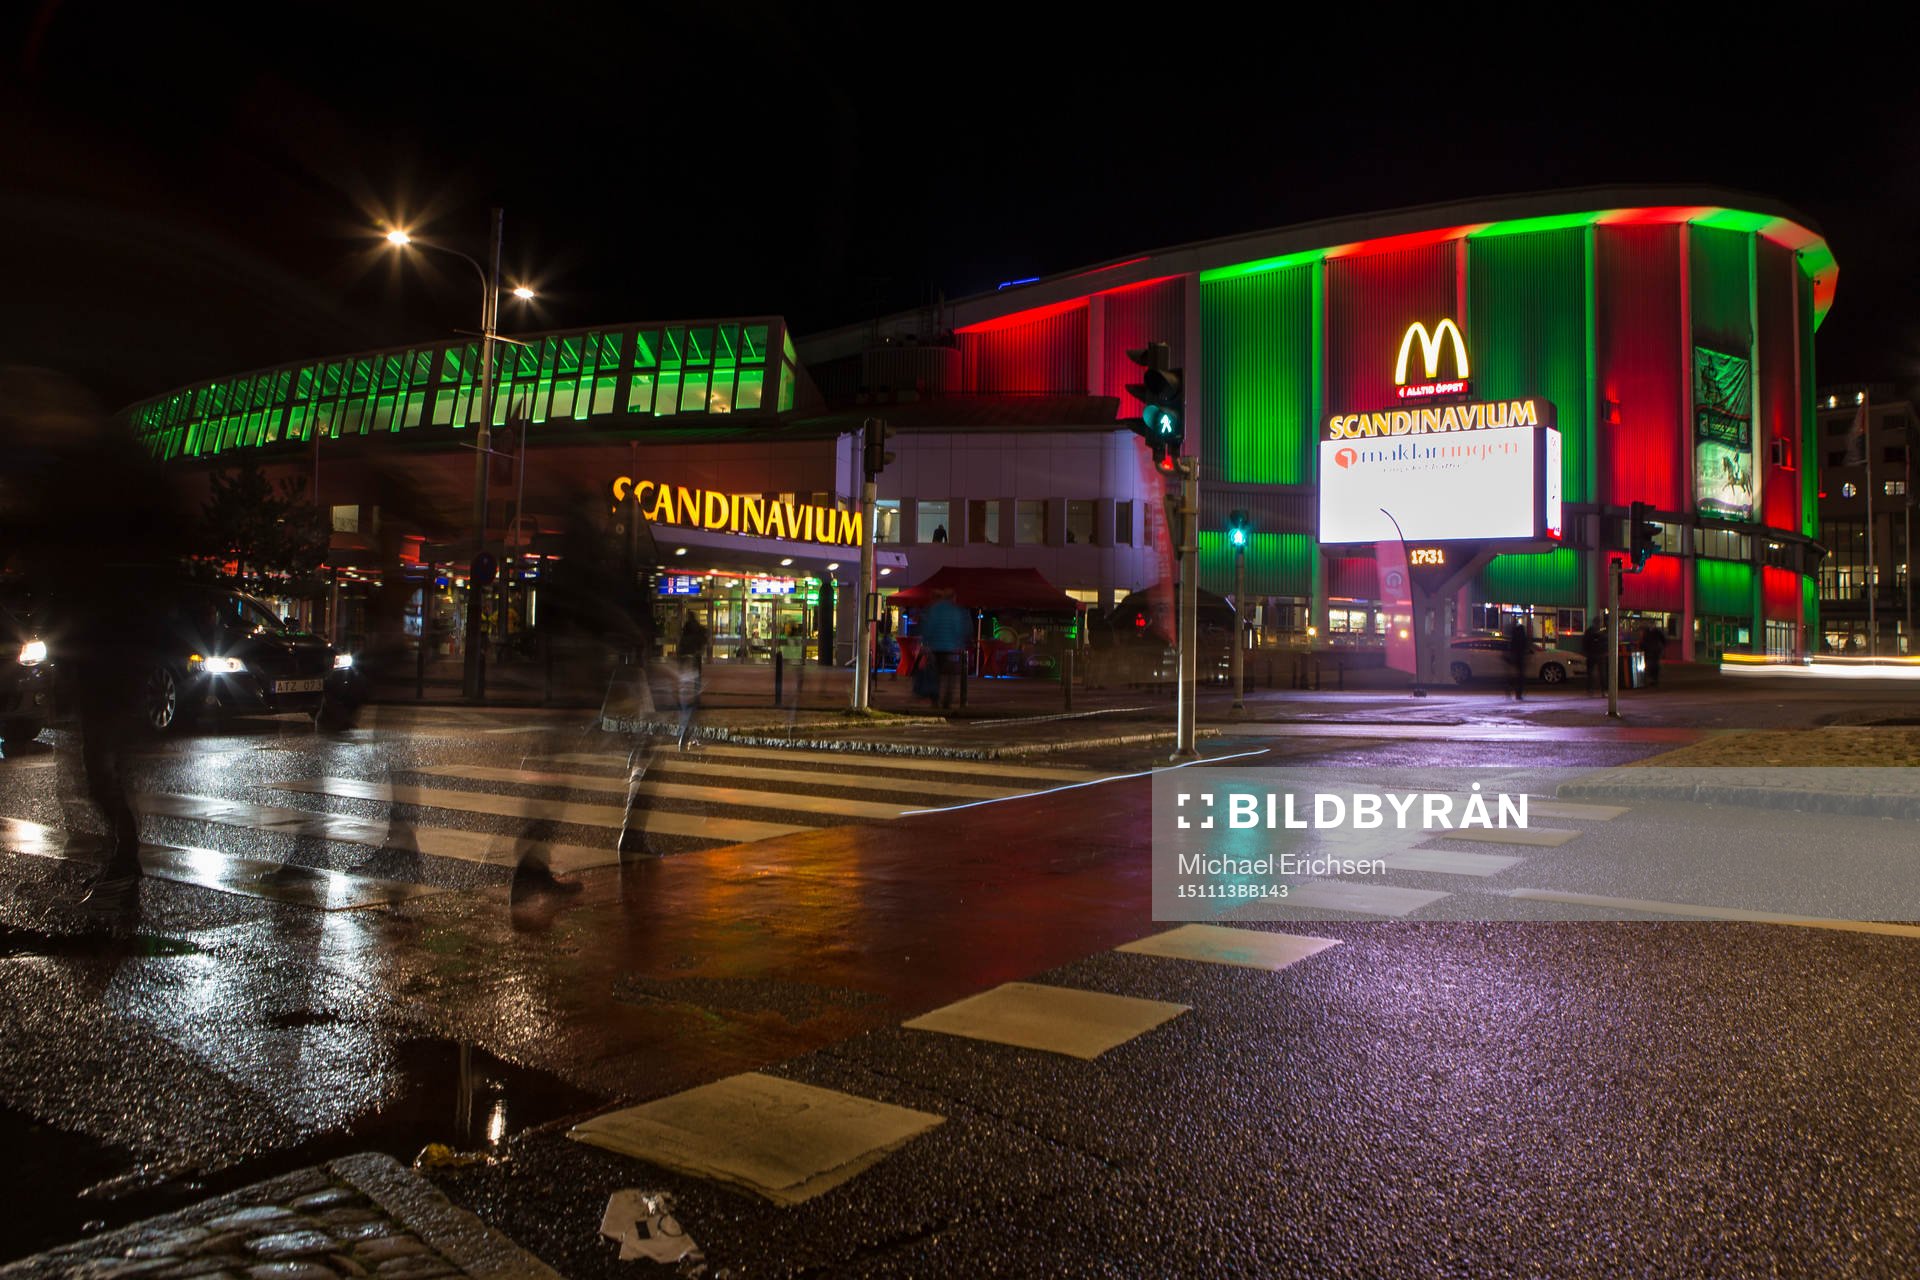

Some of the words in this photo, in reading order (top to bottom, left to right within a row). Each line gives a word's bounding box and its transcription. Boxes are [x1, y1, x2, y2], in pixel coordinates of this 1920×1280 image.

[1407, 386, 1434, 396] ALLTID
[1436, 383, 1463, 394] ÖPPET
[1330, 400, 1538, 439] SCANDINAVIUM
[612, 476, 863, 547] SCANDINAVIUM
[1411, 549, 1444, 564] 17:31
